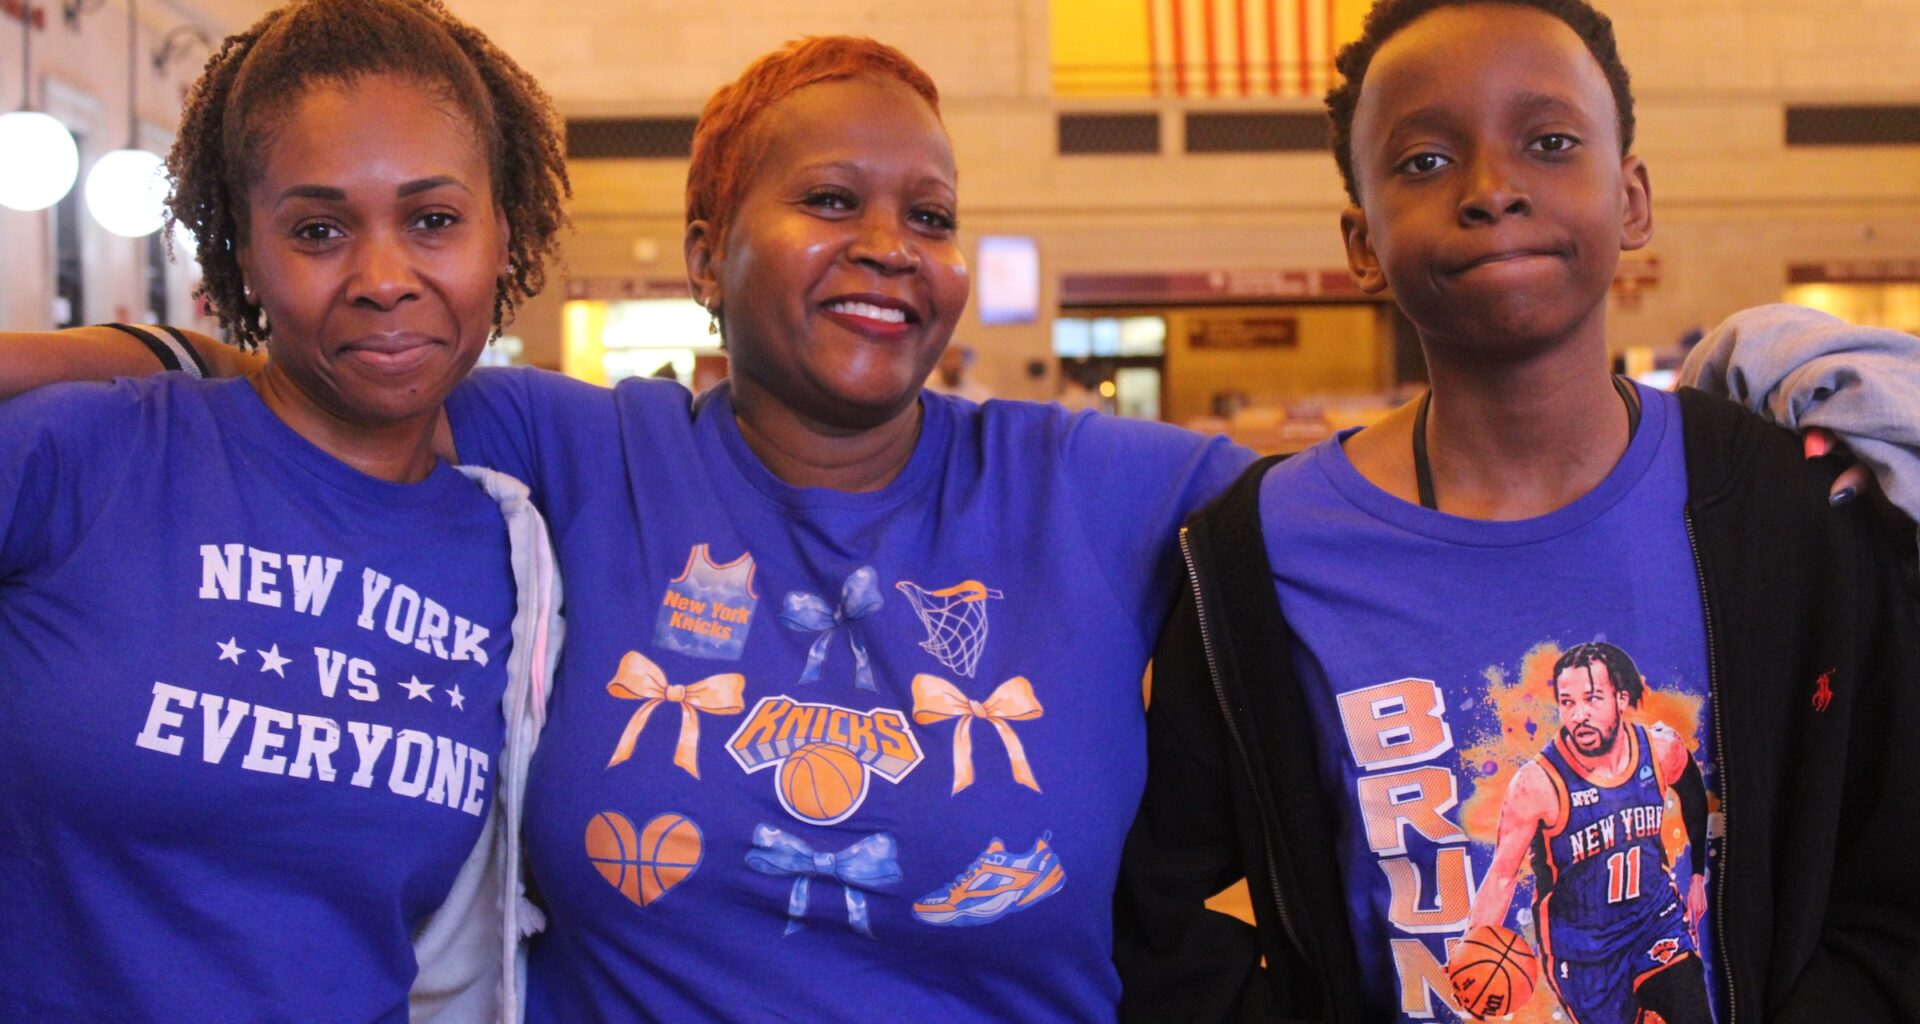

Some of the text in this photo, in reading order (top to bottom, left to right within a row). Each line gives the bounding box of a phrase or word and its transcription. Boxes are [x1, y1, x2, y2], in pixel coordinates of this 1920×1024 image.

[199, 543, 490, 668] NEW YORK
[662, 590, 751, 625] New York
[668, 610, 733, 641] Knicks
[314, 646, 380, 702] VS
[135, 681, 490, 817] EVERYONE
[732, 699, 917, 774] KNICKS
[1569, 814, 1615, 865] NEW
[1606, 845, 1641, 904] 11
